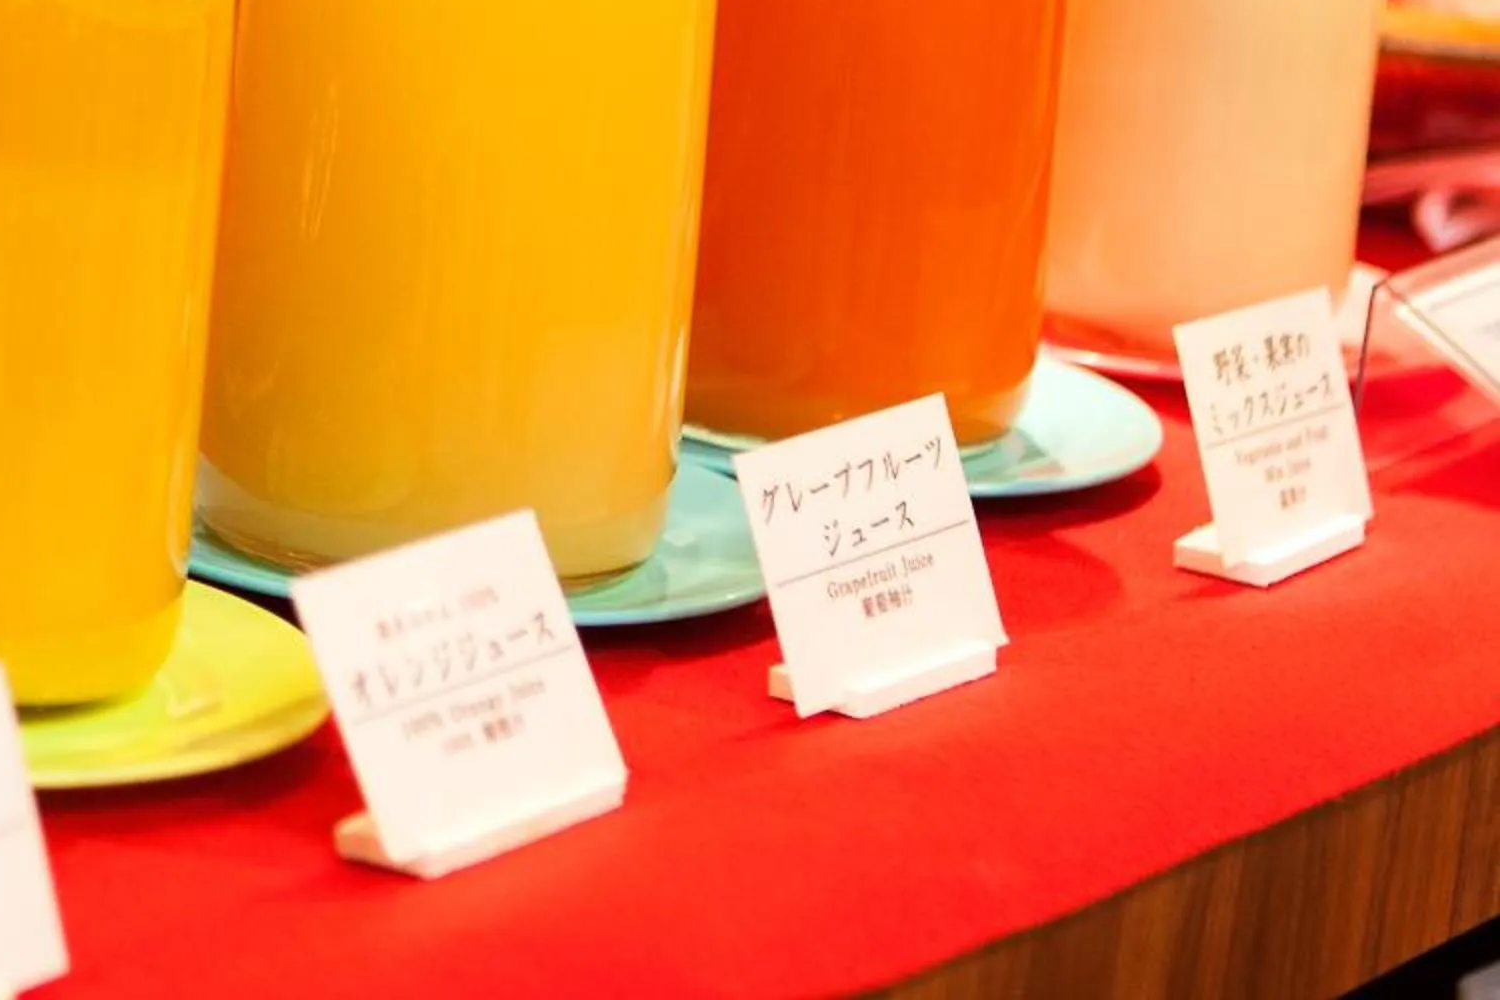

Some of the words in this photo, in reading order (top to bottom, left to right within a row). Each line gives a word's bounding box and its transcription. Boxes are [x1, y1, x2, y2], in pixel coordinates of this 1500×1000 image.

[1209, 372, 1334, 435] ミックスジュース
[760, 435, 942, 526] グレープフルーツ
[823, 500, 916, 557] ジュース
[826, 563, 899, 602] Grapefruit
[901, 552, 935, 580] Juice
[353, 611, 556, 708] オレンジジュース
